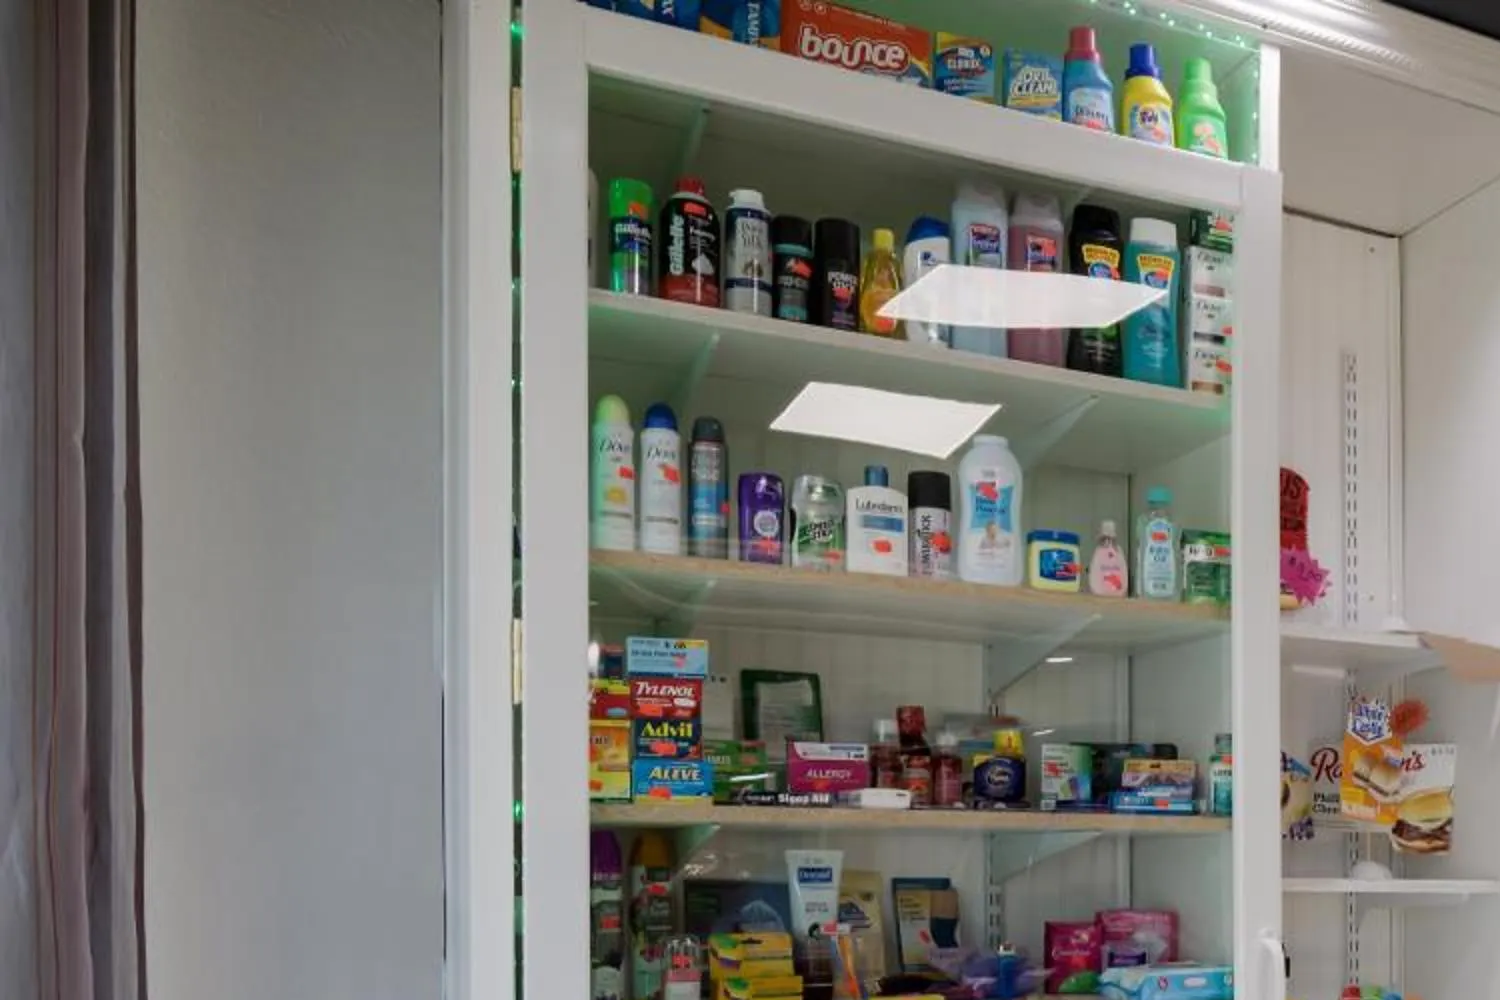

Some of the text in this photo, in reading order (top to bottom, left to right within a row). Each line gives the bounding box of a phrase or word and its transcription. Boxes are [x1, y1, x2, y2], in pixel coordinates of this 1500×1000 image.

[801, 25, 907, 68] bounce
[669, 214, 686, 276] Gillette
[636, 681, 695, 698] TYLENOL
[641, 721, 694, 738] Advil
[650, 766, 702, 781] ALEVE
[806, 769, 852, 780] ALLERGY
